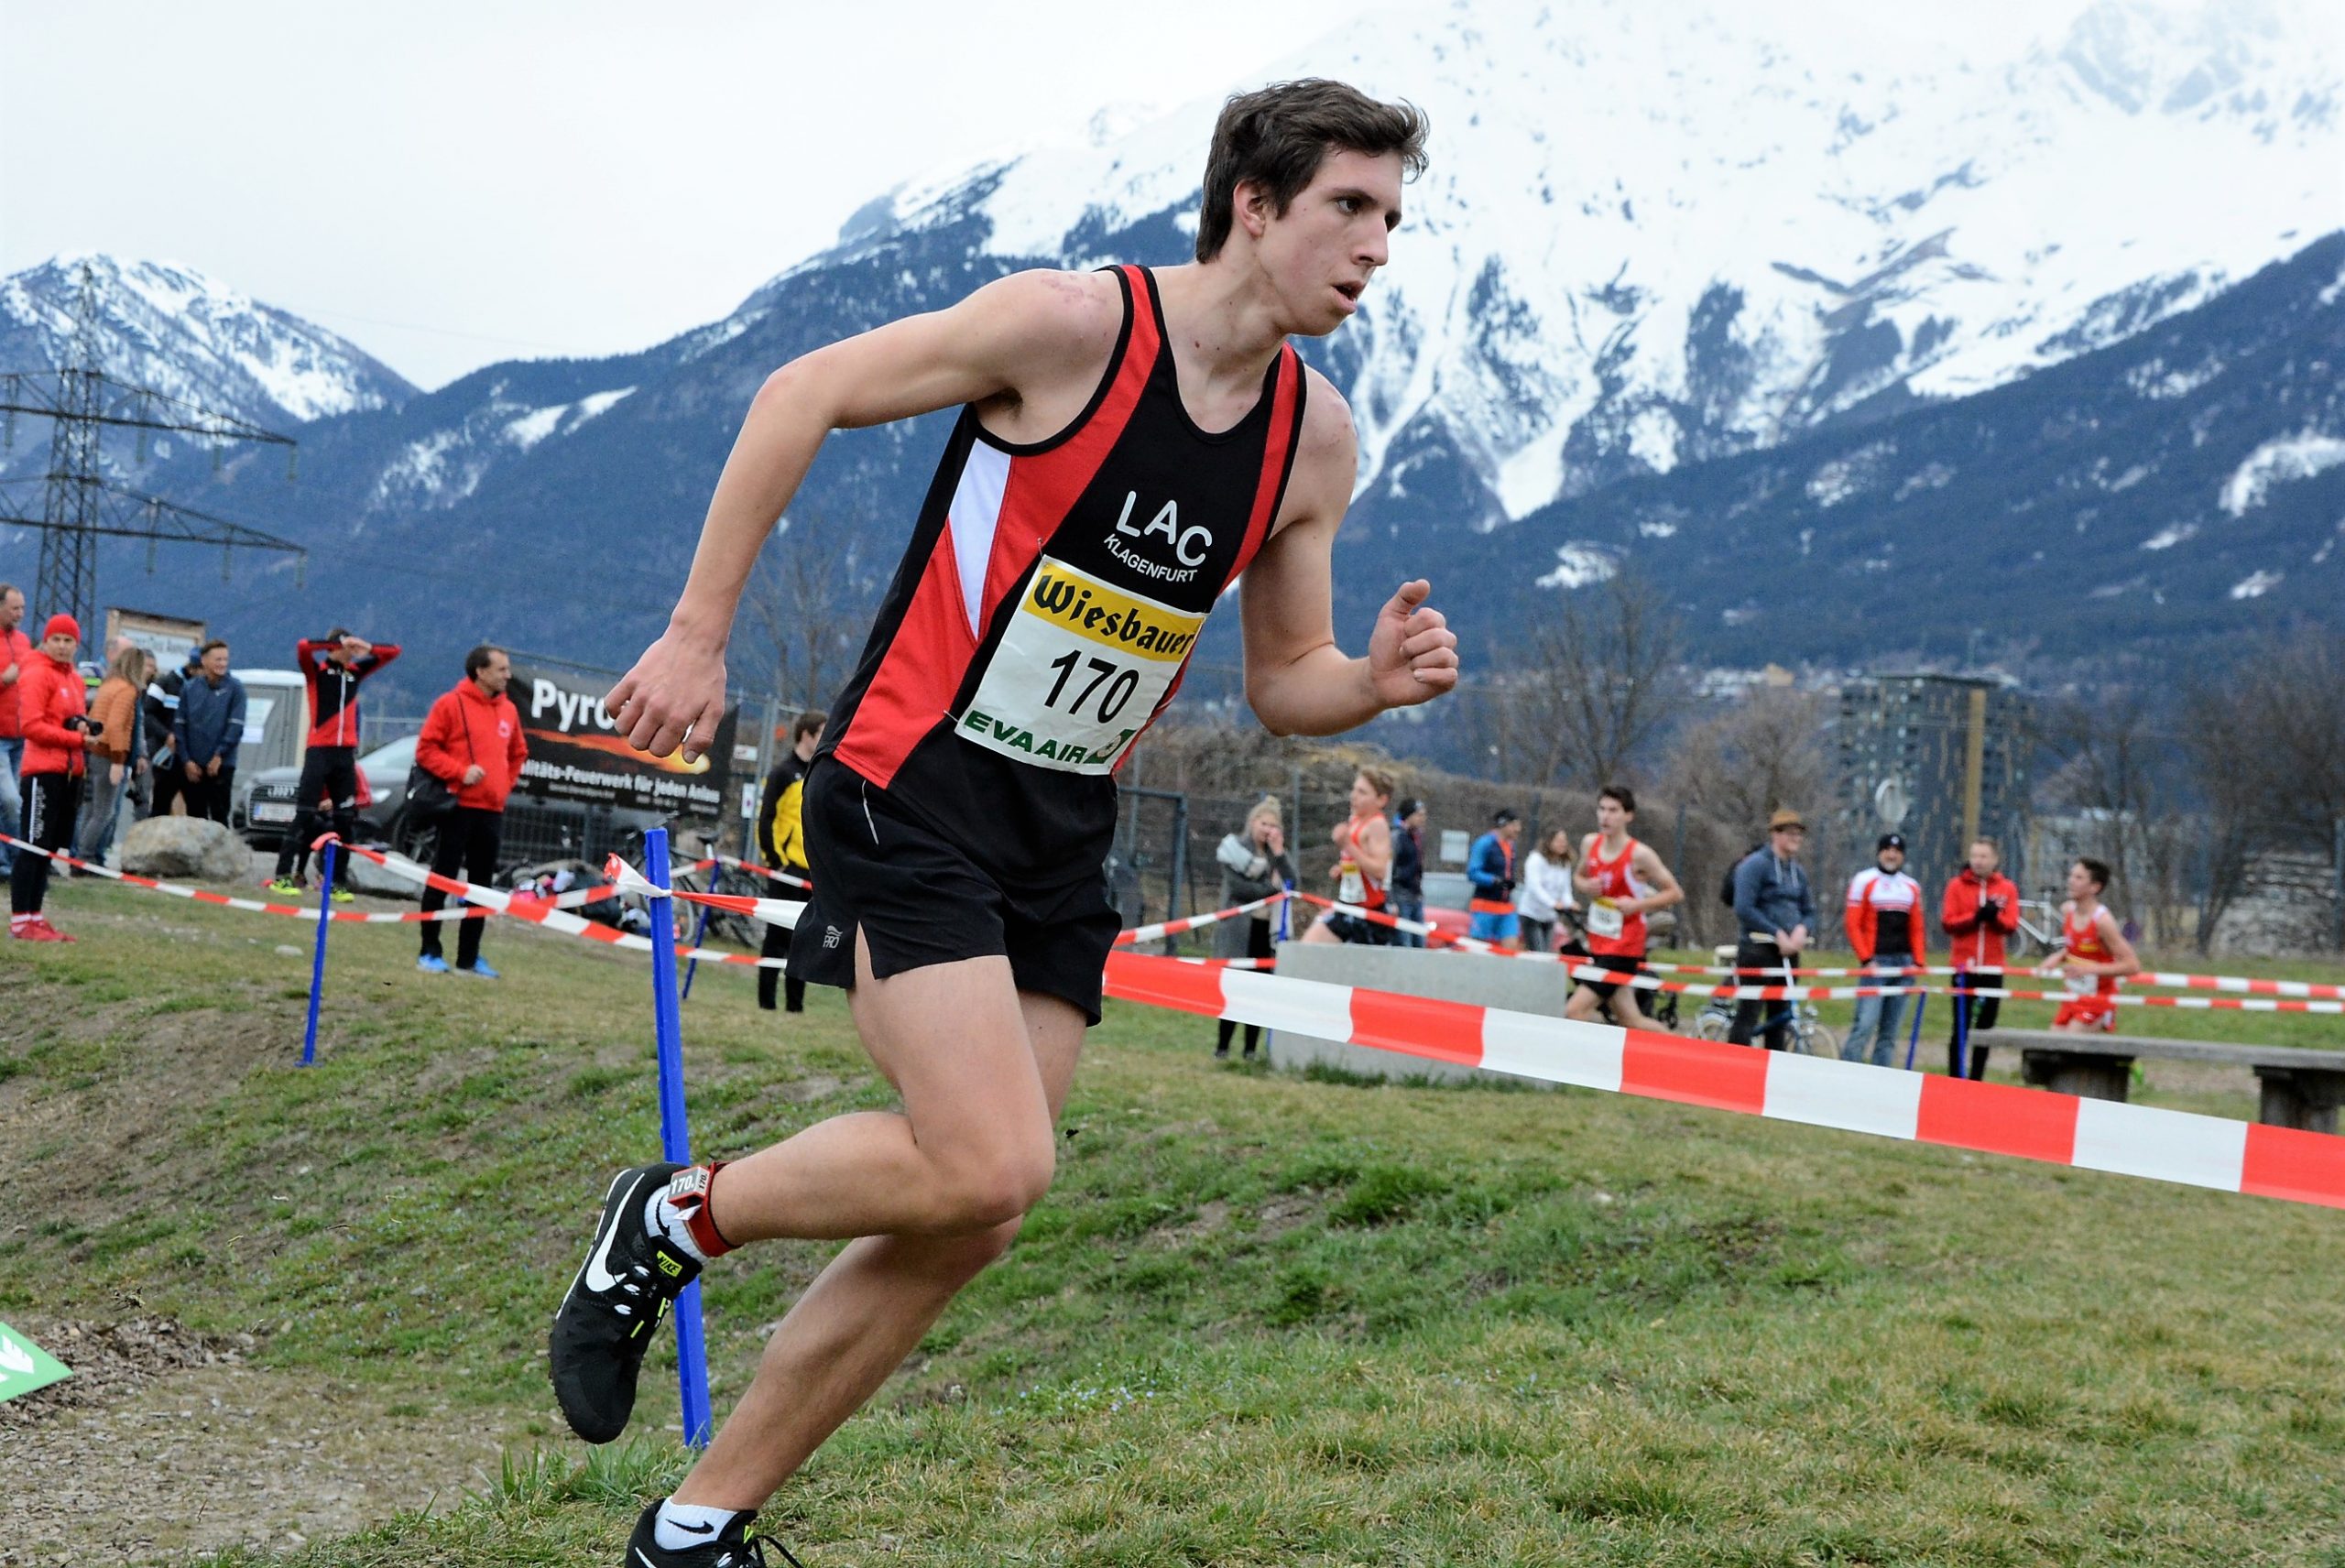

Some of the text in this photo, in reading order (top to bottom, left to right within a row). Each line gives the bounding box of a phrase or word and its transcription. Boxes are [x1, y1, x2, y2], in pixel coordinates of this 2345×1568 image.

[1116, 490, 1213, 567] LAC
[1103, 533, 1198, 583] KLAGENFURT
[1044, 649, 1140, 724] 170
[671, 1174, 695, 1194] 170.
[657, 1256, 682, 1274] NIKE
